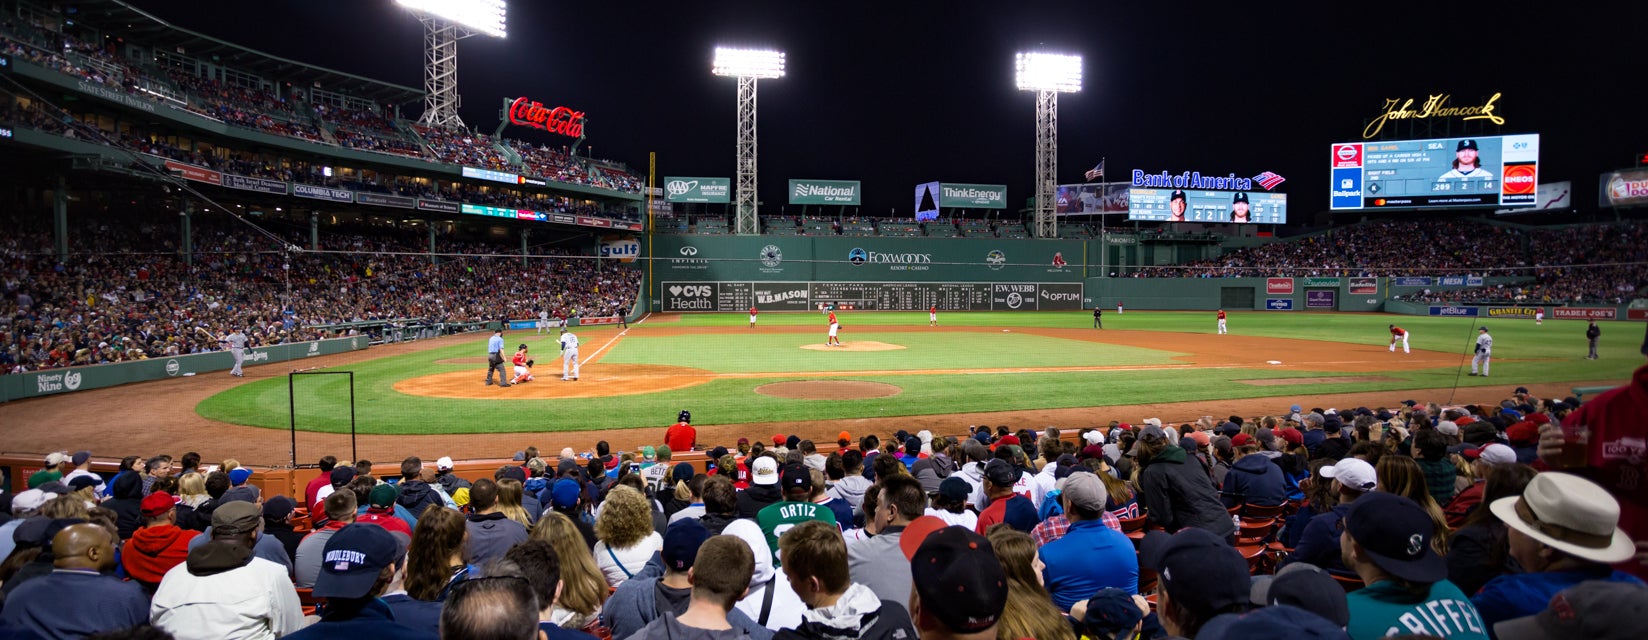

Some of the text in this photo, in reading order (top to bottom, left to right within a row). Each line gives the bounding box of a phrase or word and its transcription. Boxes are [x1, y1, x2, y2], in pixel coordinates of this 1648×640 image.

[78, 81, 155, 112] STATE STREET PAVILION
[510, 97, 585, 138] Coca-Cola
[1363, 92, 1505, 139] John Hancock
[1132, 169, 1252, 190] Bank of America
[294, 184, 350, 200] COLUMBIA TECH
[669, 181, 688, 195] AAA
[808, 185, 855, 197] National
[944, 187, 1001, 201] ThinkEnergy
[1195, 210, 1201, 220] 2
[1207, 211, 1213, 220] 2
[601, 244, 637, 257] Gulf
[869, 251, 931, 264] FOXWOODS
[1443, 277, 1464, 285] NESN
[683, 285, 712, 297] CVS
[1010, 284, 1035, 293] WEBB
[670, 297, 712, 309] Health
[1050, 293, 1080, 301] OPTUM
[1440, 306, 1467, 316] jetBlue
[1489, 307, 1538, 316] GRANITE CIT
[1555, 309, 1614, 317] TRADER JOE'S
[37, 374, 63, 384] Ninety
[38, 381, 63, 393] Nine
[780, 503, 817, 519] ORTIZ
